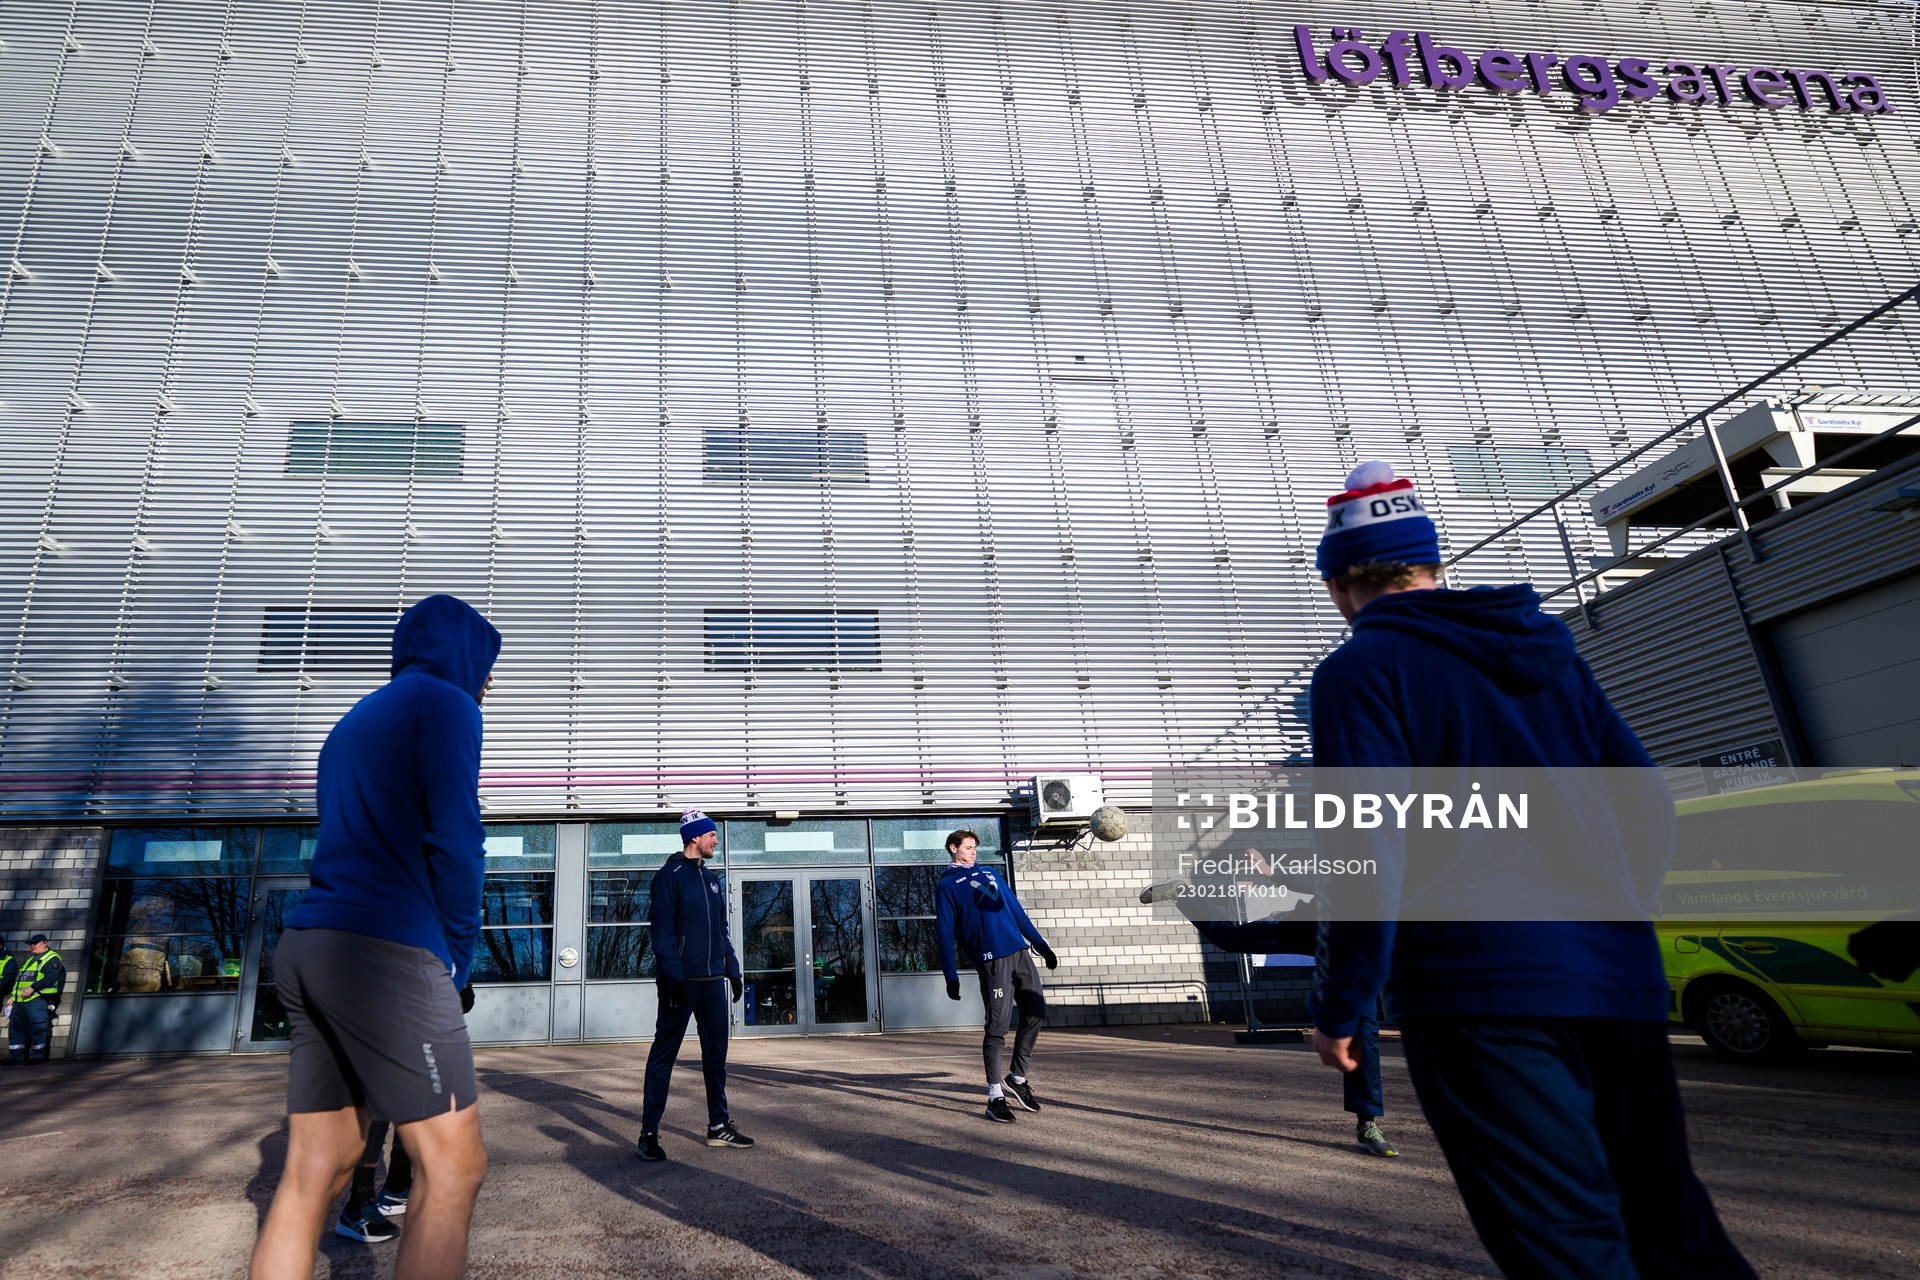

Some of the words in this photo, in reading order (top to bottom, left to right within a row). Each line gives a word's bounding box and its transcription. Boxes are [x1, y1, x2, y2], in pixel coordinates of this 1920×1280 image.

[1294, 25, 1895, 115] löfbergsarena
[1720, 746, 1761, 765] ENTRÉ
[1725, 771, 1771, 789] PUBLIK
[1679, 888, 1750, 904] Värmlands
[1755, 884, 1869, 904] Eventsjukvård
[982, 951, 993, 960] 76
[993, 987, 1004, 999] 76
